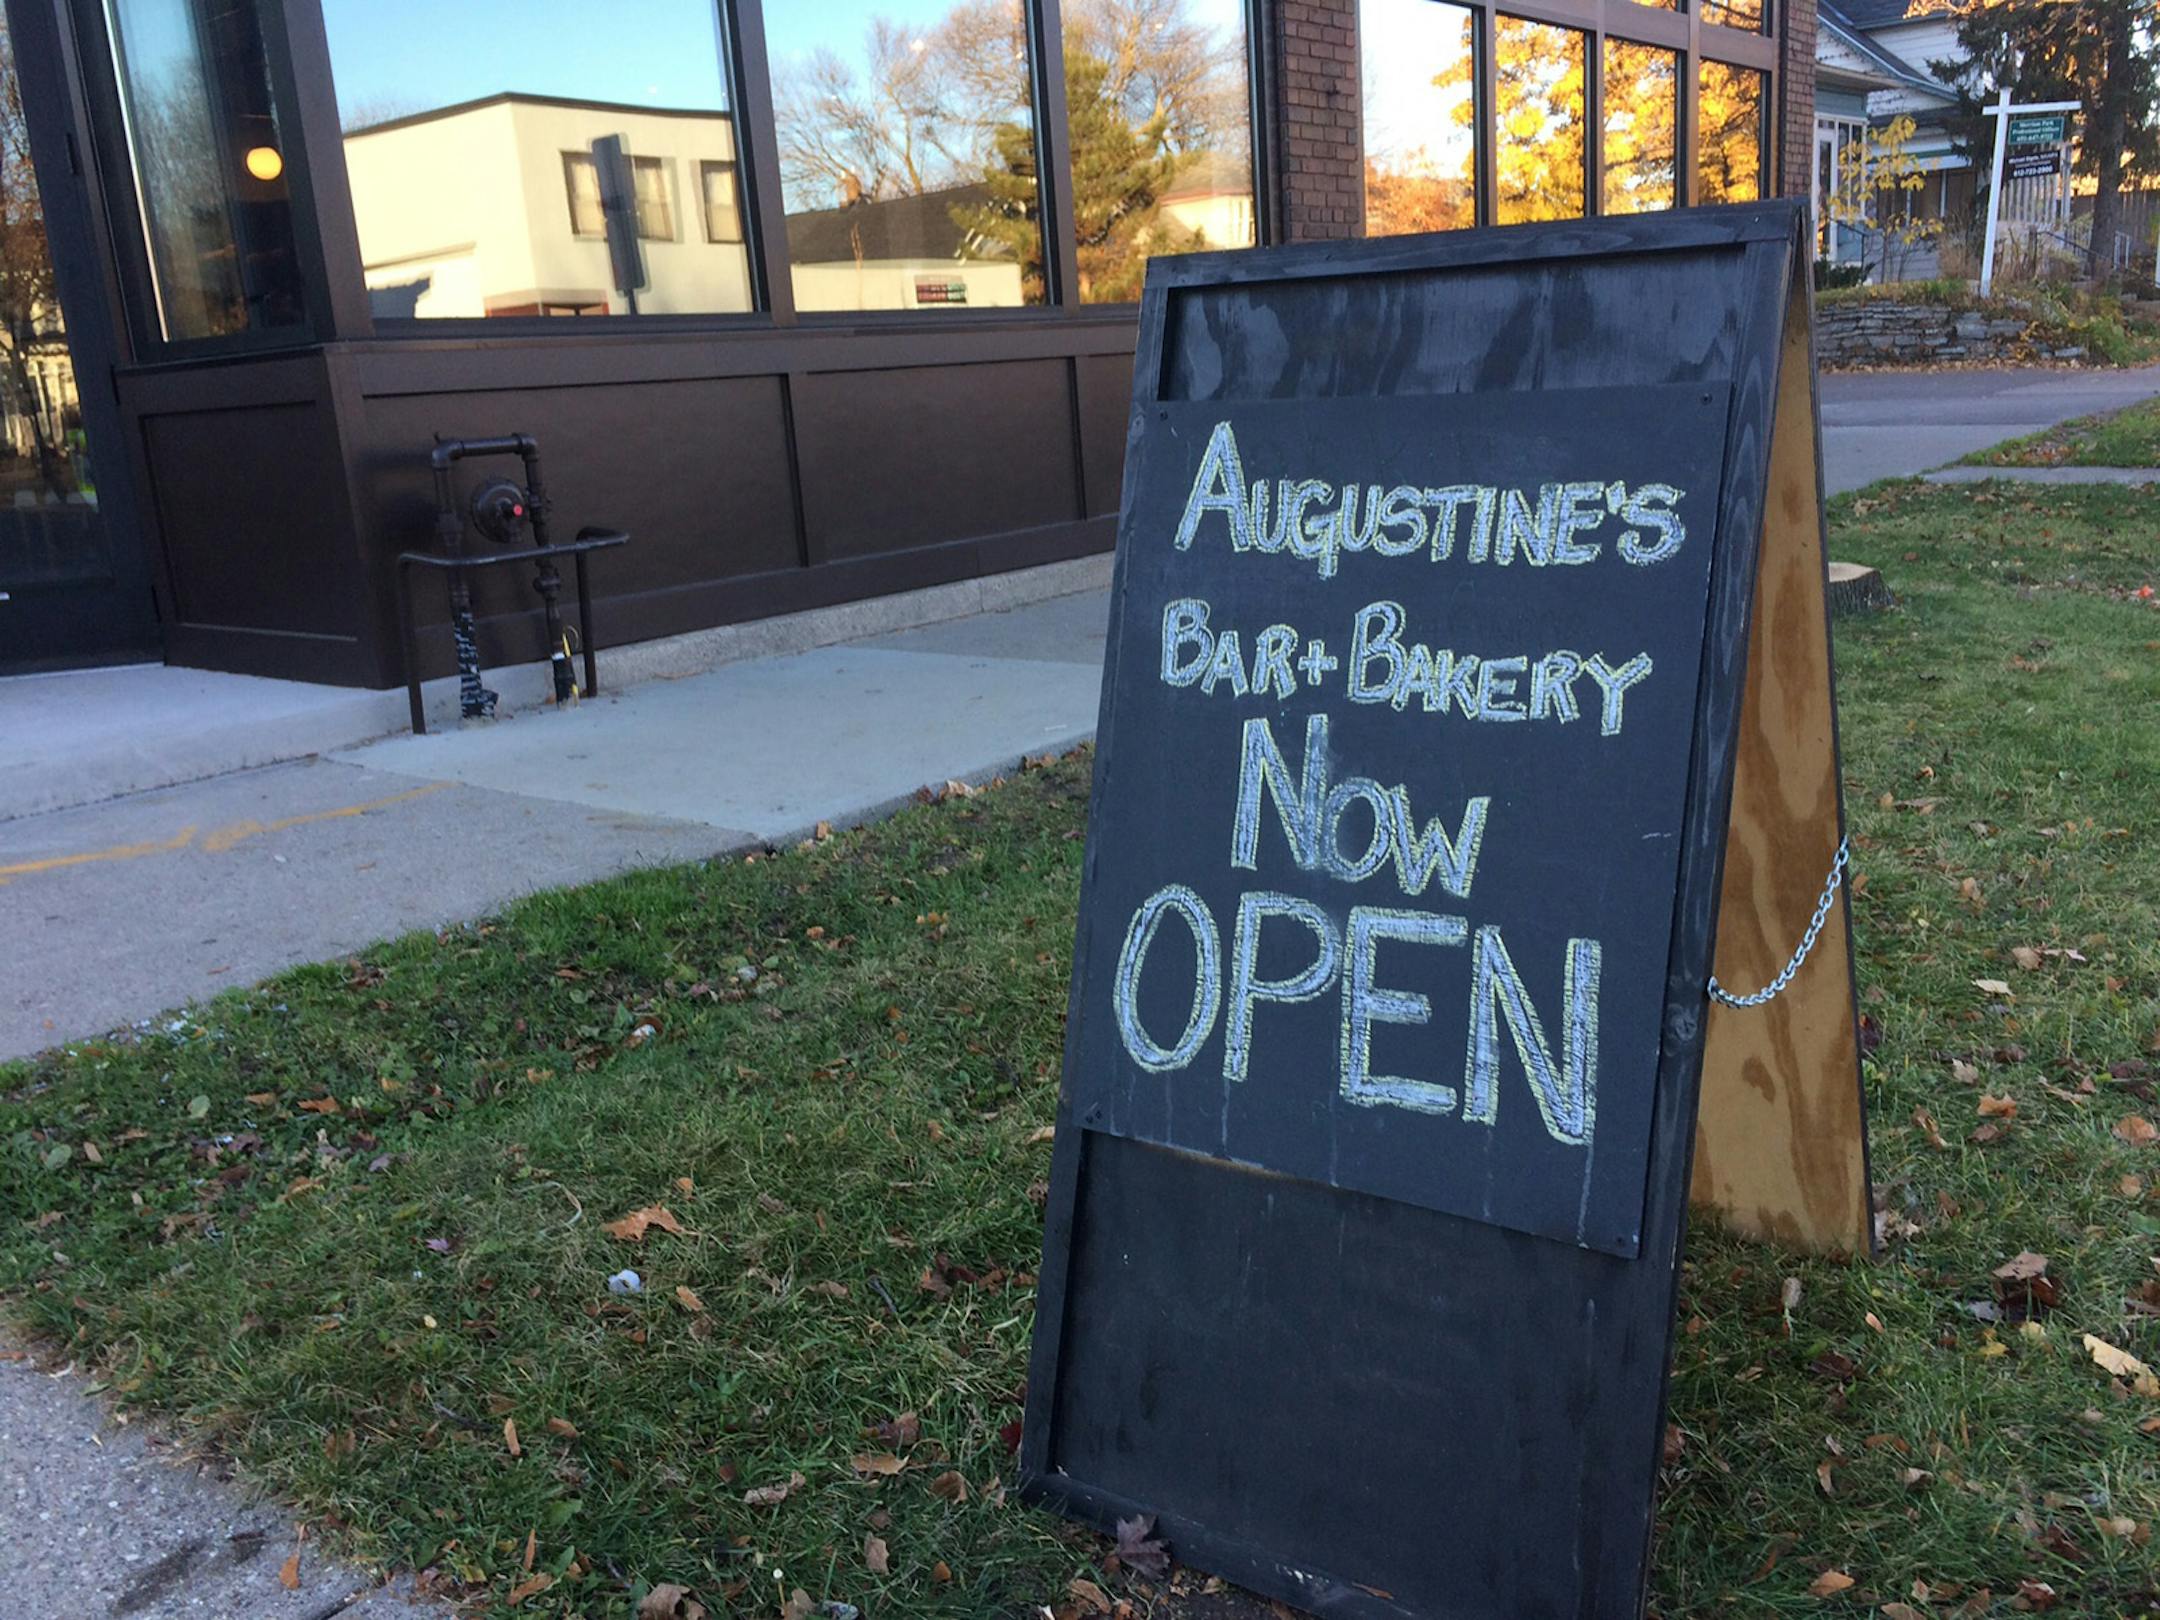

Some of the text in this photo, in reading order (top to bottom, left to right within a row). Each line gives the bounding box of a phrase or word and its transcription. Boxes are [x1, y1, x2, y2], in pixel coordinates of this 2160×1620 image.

[1173, 420, 1687, 580] AUGUSTINE'S
[1347, 600, 1654, 737] BAKERY
[1230, 713, 1492, 898] NOW
[1112, 883, 1602, 1146] OPEN
